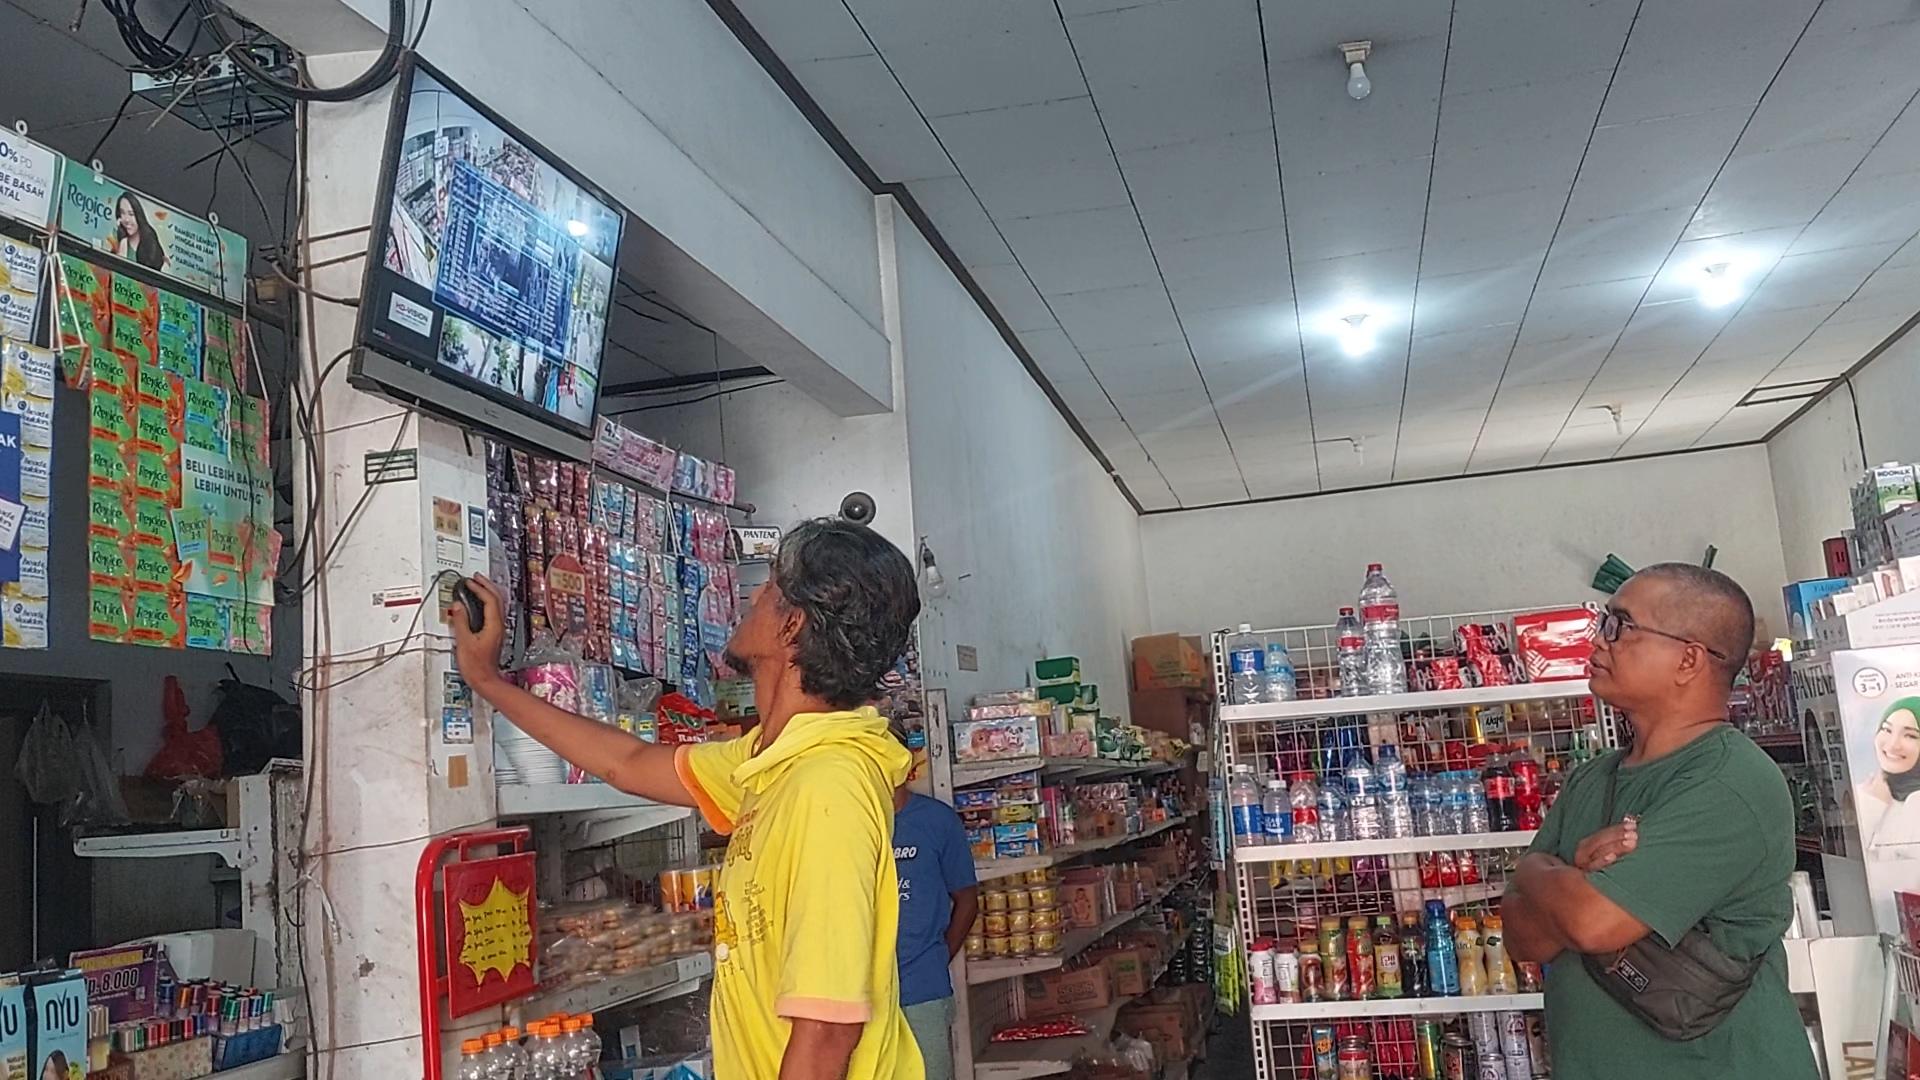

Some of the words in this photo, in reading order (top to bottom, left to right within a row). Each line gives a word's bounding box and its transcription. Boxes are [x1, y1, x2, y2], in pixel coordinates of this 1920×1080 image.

[12, 178, 44, 199] BASAH
[67, 182, 112, 221] Rejoice
[186, 459, 206, 474] BELI
[208, 464, 235, 481] LEBIH
[194, 478, 221, 495] LEBIH
[743, 530, 777, 539] PANTENE
[1792, 662, 1836, 699] PANTENE
[102, 967, 139, 994] 8.000
